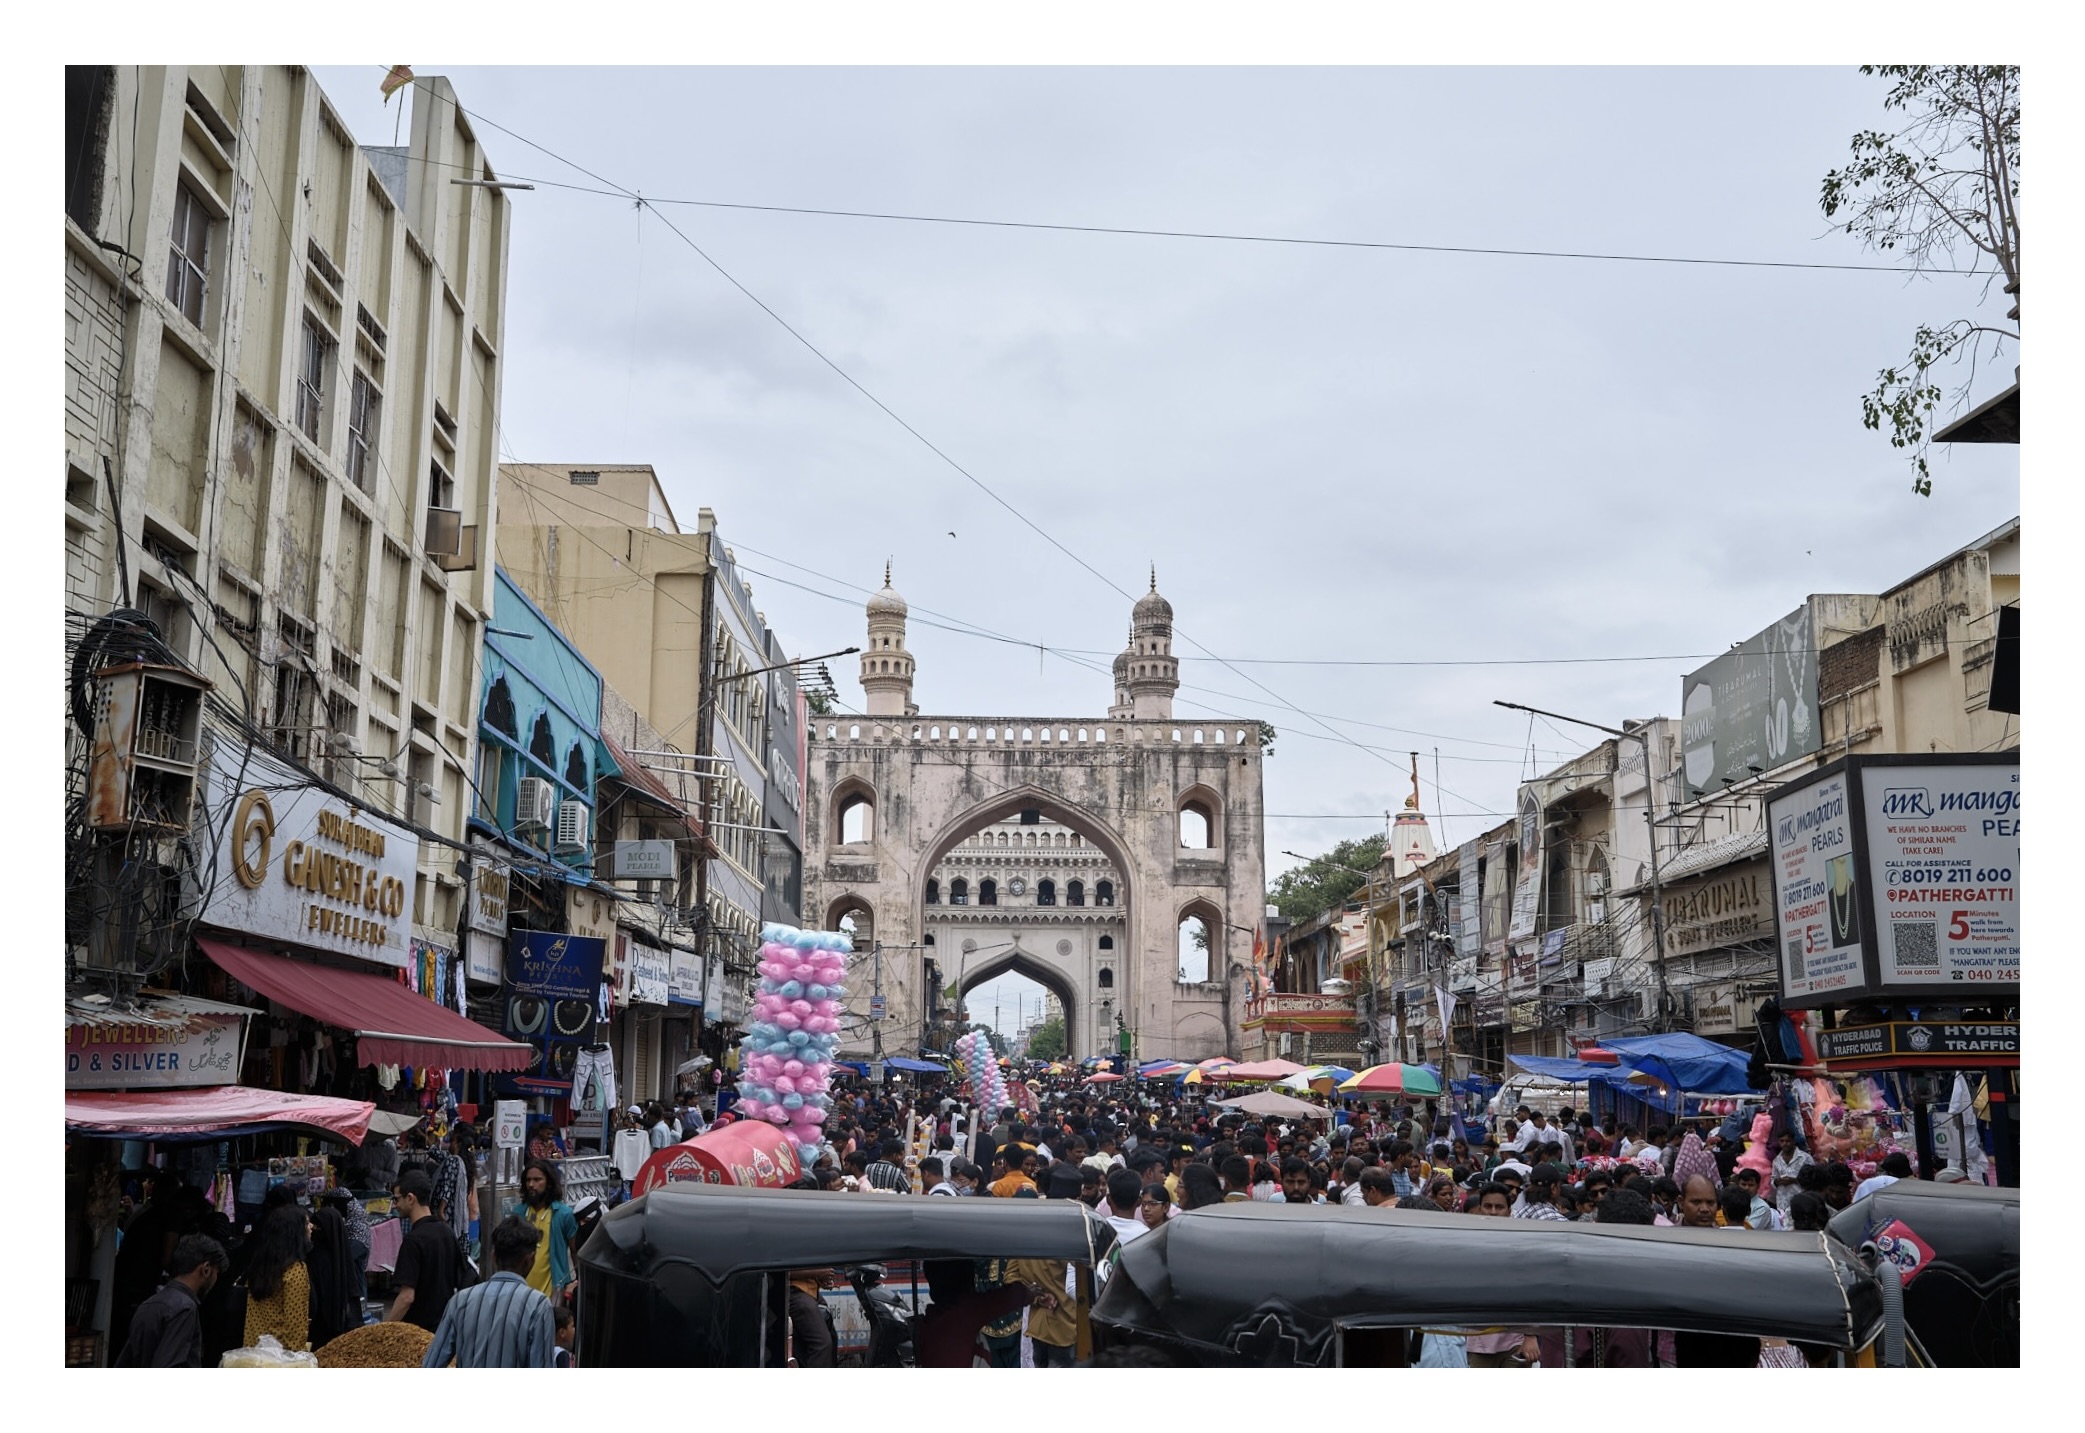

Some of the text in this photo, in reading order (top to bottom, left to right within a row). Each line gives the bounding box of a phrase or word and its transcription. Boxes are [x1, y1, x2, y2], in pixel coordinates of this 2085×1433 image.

[1717, 670, 1762, 697] TIBARUMAL
[1684, 715, 1714, 746] 2000/-
[1796, 792, 1843, 834] mangatrai
[1887, 825, 1967, 834] WE HAVE NO BRANCHES
[1812, 826, 1844, 853] PEARLS
[1896, 836, 1957, 844] OF SIMILAR NAME
[627, 852, 661, 862] MODI
[1902, 847, 1944, 856] (TAKE CARE)
[626, 862, 661, 870] PEARLS
[284, 839, 405, 918] GANESH & CO
[1902, 868, 2012, 883] 8019 211 600
[1788, 881, 1825, 904] 8019 211 600
[1898, 888, 2013, 902] PATHERGATTI
[1666, 875, 1760, 927] TIBARUMAL
[1788, 900, 1827, 923] PATHERGATTI
[1890, 910, 1936, 918] LOCATION
[1948, 910, 1970, 941] 5
[1806, 924, 1814, 954] 5
[1972, 947, 1992, 955] WANT
[523, 960, 583, 977] KRISHNA
[1968, 970, 1992, 980] 040
[80, 1024, 189, 1048] JEWELLERS
[1832, 1028, 1882, 1043] HYDERABAD
[1944, 1026, 2020, 1036] HYDER
[1834, 1042, 1882, 1056] TRAFFIC POLICE
[1944, 1040, 2016, 1050] TRAFFIC
[68, 1052, 180, 1072] D & SILVER
[838, 1331, 870, 1341] HYD
